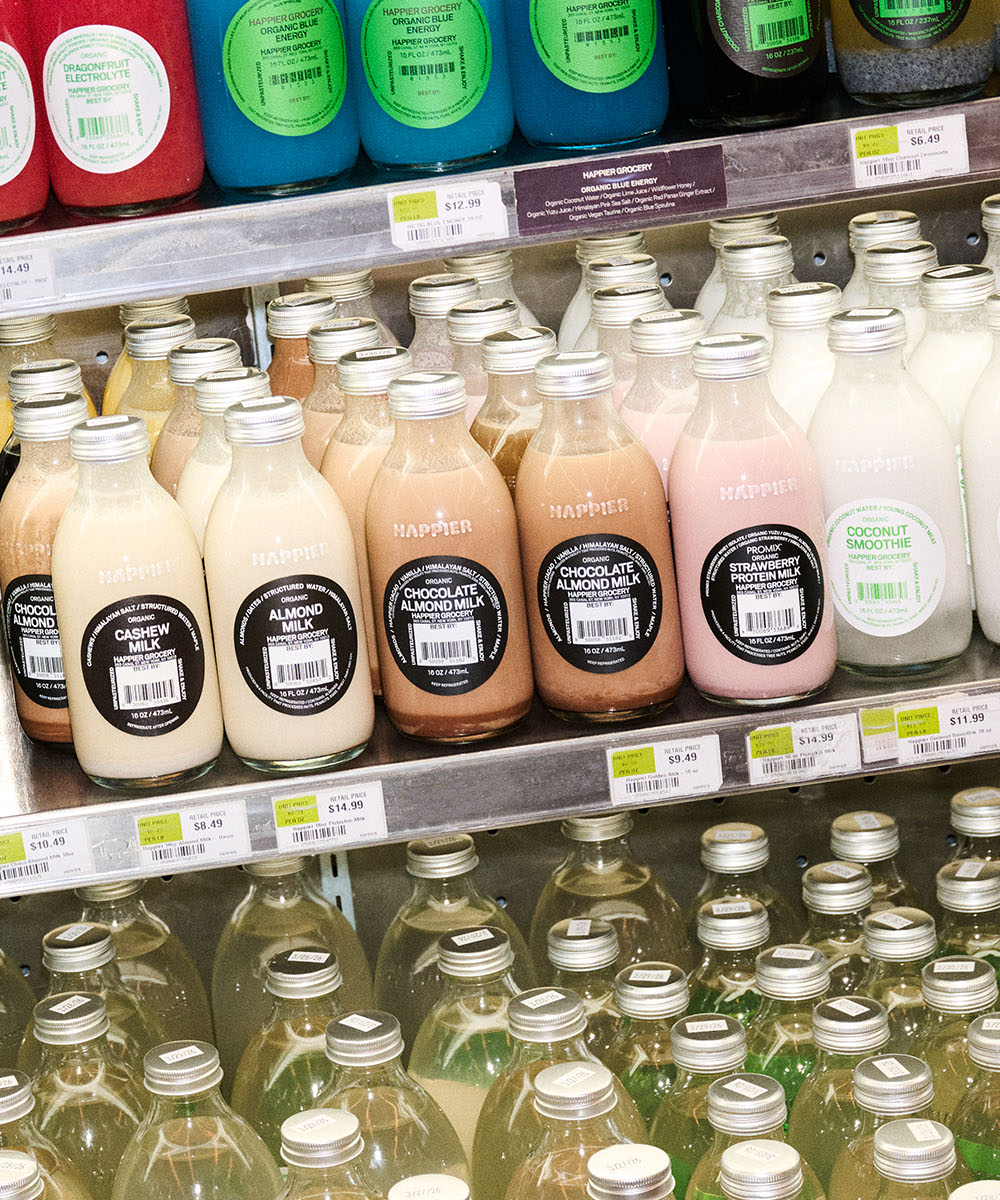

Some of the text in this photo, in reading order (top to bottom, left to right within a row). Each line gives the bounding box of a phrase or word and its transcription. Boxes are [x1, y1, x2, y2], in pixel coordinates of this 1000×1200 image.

[383, 2, 462, 16] HAPPIER GROCERY
[393, 14, 453, 25] ORGANIC BLUE
[407, 25, 441, 34] ENERGY
[63, 59, 130, 73] DRAGONFRUIT
[66, 69, 131, 83] ELECTROLYTE
[910, 134, 940, 146] $6.49
[583, 163, 652, 179] HAPPIER GROCERY
[581, 177, 657, 193] ORGANIC BLUE ENERGY
[635, 187, 647, 195] Juice
[445, 199, 481, 211] $12.99
[569, 213, 587, 221] Organic
[655, 202, 675, 210] Spirulina
[550, 499, 629, 518] HAPPIER
[394, 520, 472, 537] HAPPIER
[847, 526, 908, 537] COCONUT
[747, 544, 781, 555] PROMIX
[846, 537, 912, 549] SMOOTHIE
[752, 553, 779, 561] ORGANIC
[560, 563, 634, 578] CHOCOLATE
[730, 556, 800, 573] STRAWBERRY
[731, 566, 801, 583] PROTEIN MILK
[556, 574, 640, 591] ALMOND MILK
[404, 584, 478, 599] CHOCOLATE
[568, 587, 630, 598] HAPPIER GROCERY
[401, 595, 485, 612] ALMOND MILK
[269, 603, 323, 621] ALMOND
[13, 616, 54, 628] ALMOND
[282, 618, 313, 632] MILK
[114, 623, 170, 641] CASHEW
[129, 639, 161, 653] MILK
[949, 712, 985, 726] $11.99
[799, 733, 834, 745] $14.99
[664, 744, 701, 754] RETAIL PRICE
[668, 752, 697, 764] $9.49
[328, 801, 363, 813] $14.99
[194, 819, 222, 831] $8.49
[30, 837, 65, 850] $10.49
